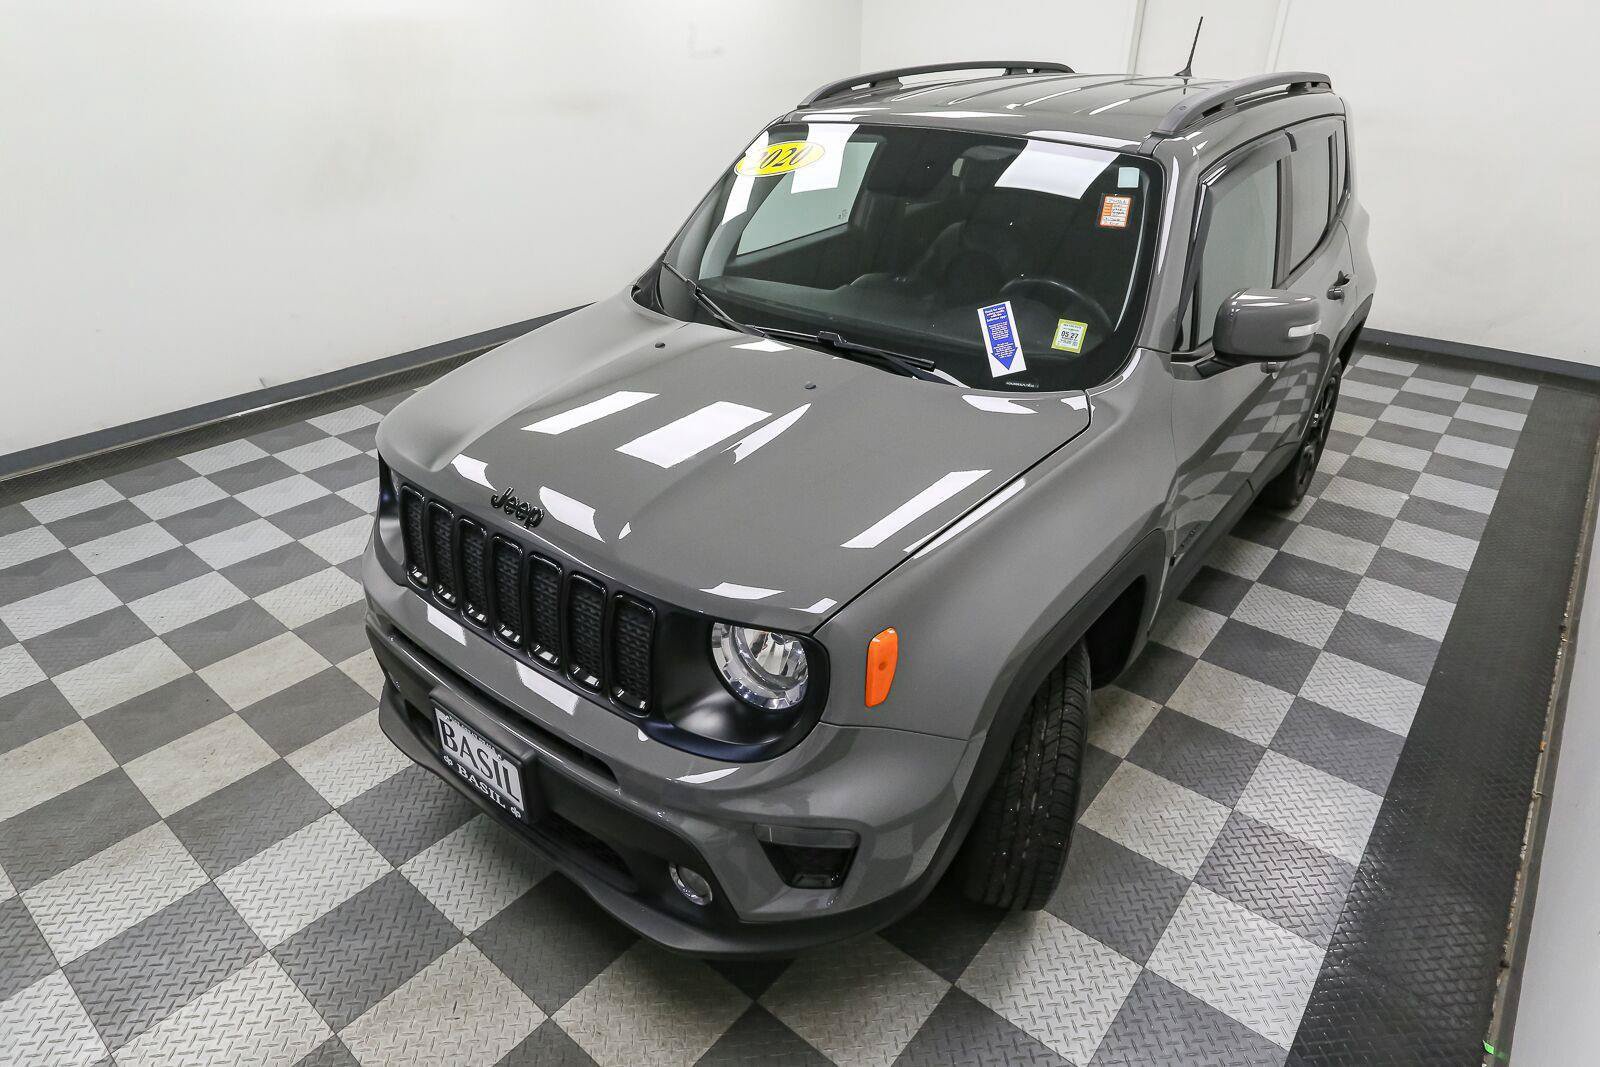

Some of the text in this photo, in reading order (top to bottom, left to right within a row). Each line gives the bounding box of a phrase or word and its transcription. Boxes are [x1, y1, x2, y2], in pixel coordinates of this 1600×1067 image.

[749, 145, 814, 171] 020
[491, 487, 545, 529] Jeep
[440, 718, 520, 803] BASIL
[457, 763, 506, 809] BASIL
